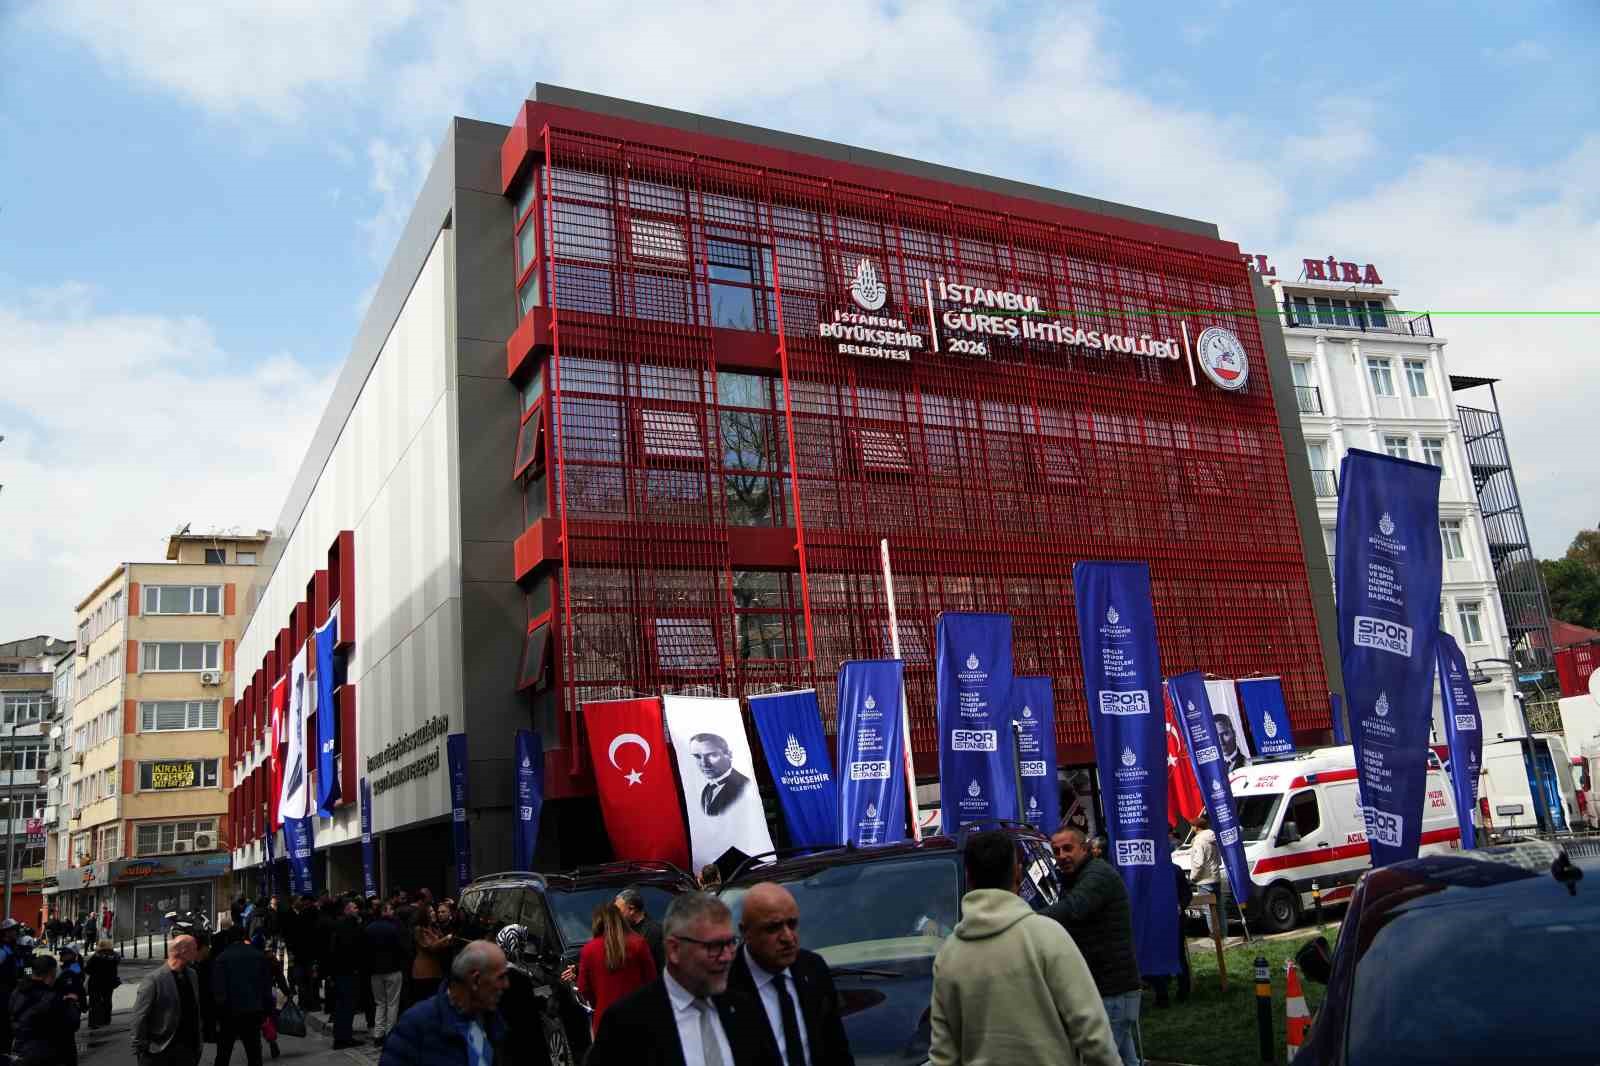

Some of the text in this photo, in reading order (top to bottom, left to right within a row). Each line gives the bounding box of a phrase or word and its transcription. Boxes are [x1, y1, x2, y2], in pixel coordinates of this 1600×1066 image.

[1303, 256, 1383, 285] HİRA
[939, 277, 1046, 313] İSTANBUL
[820, 322, 923, 349] BÜYÜKŞEHİR
[944, 308, 1019, 338] GÜREŞ
[1022, 315, 1101, 349] İHTİSAS
[1103, 332, 1180, 361] KULÜBÜ
[838, 343, 911, 361] BELEDİYESİ
[947, 338, 987, 356] 2026
[1358, 619, 1408, 644] SPOR
[1102, 692, 1146, 705] SPOR
[1103, 704, 1147, 713] İSTANBUL
[955, 731, 993, 742] SPOR
[853, 762, 887, 773] SPOR
